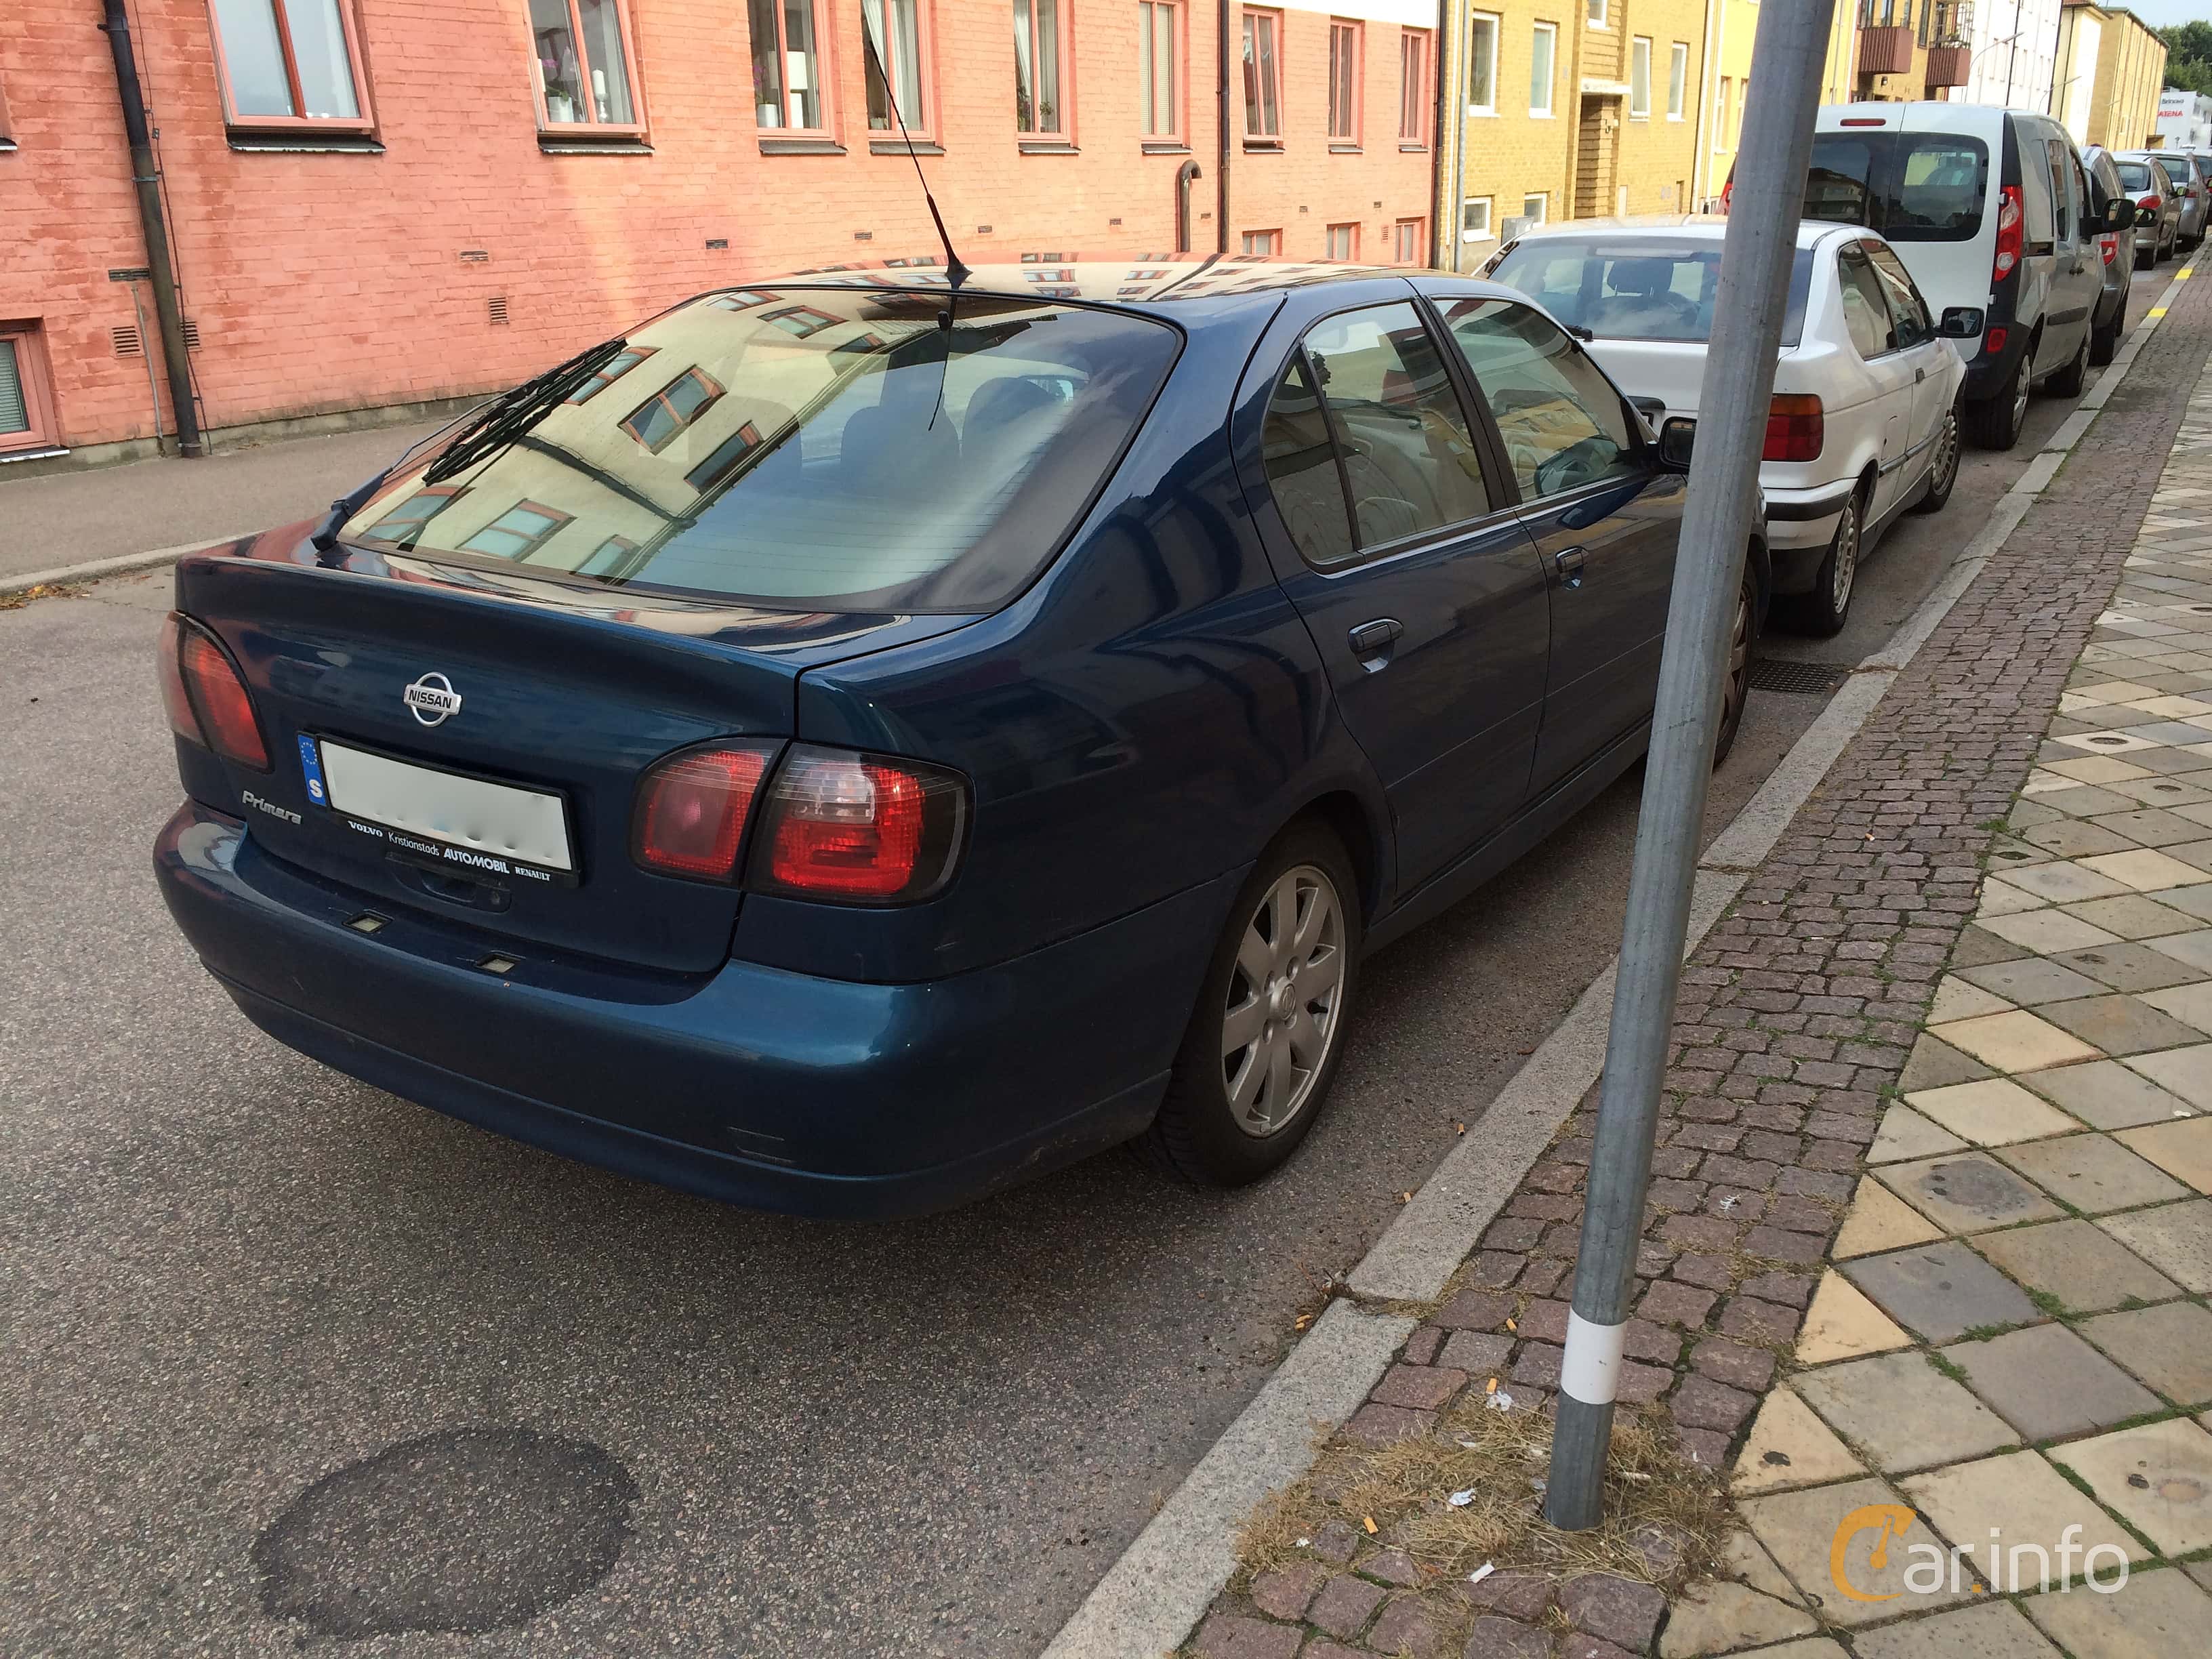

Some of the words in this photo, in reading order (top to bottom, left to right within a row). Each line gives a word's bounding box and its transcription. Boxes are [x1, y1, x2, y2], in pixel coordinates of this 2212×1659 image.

[409, 689, 452, 709] NISSAN
[309, 779, 323, 798] S
[348, 821, 383, 838] VOLVO
[388, 832, 440, 856] Kristianstads
[443, 848, 510, 874] AUTOMOBIL
[514, 866, 551, 881] RENAULT
